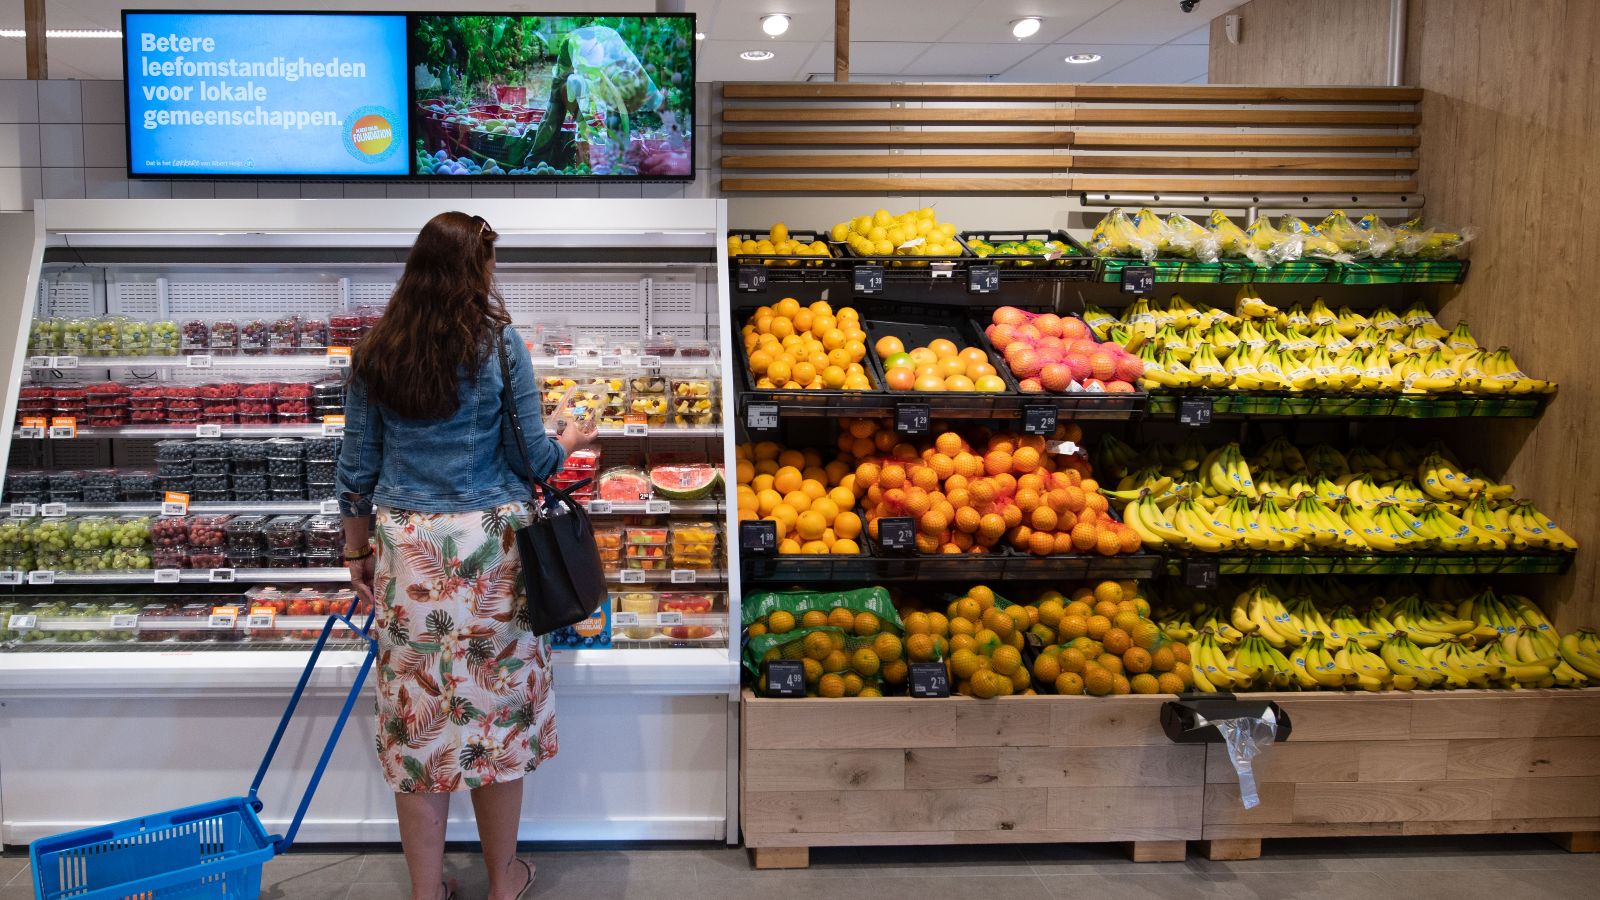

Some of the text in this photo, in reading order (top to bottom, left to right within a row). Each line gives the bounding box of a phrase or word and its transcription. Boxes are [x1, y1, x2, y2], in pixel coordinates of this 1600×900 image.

[141, 33, 215, 52] Betere
[142, 57, 366, 81] leefomstandigheden
[142, 81, 267, 101] voor lokale
[143, 106, 343, 129] gemeenschappen.
[353, 129, 392, 142] FOUNDATION
[1040, 417, 1055, 429] 2.99
[787, 673, 802, 687] 4.99
[930, 676, 945, 689] 2.79
